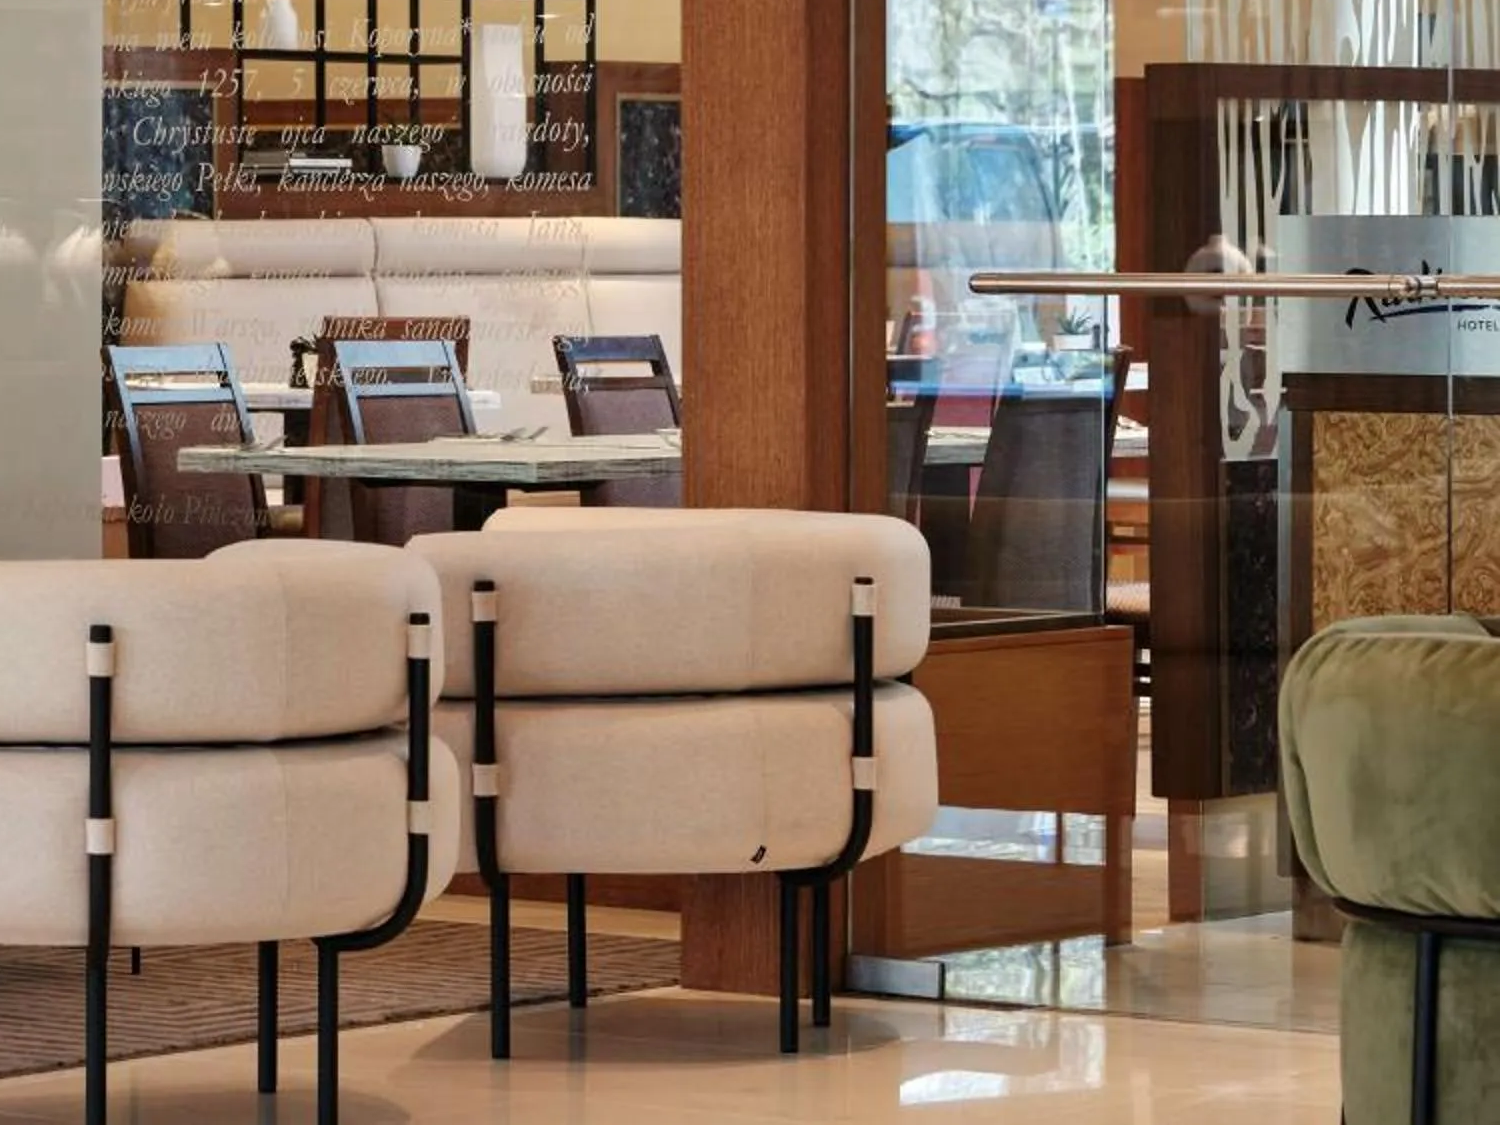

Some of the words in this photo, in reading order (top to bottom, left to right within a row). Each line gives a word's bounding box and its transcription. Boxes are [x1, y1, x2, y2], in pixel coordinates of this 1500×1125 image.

[132, 116, 258, 154] Chrystusie
[280, 117, 326, 154] ojca
[350, 115, 445, 152] naszego
